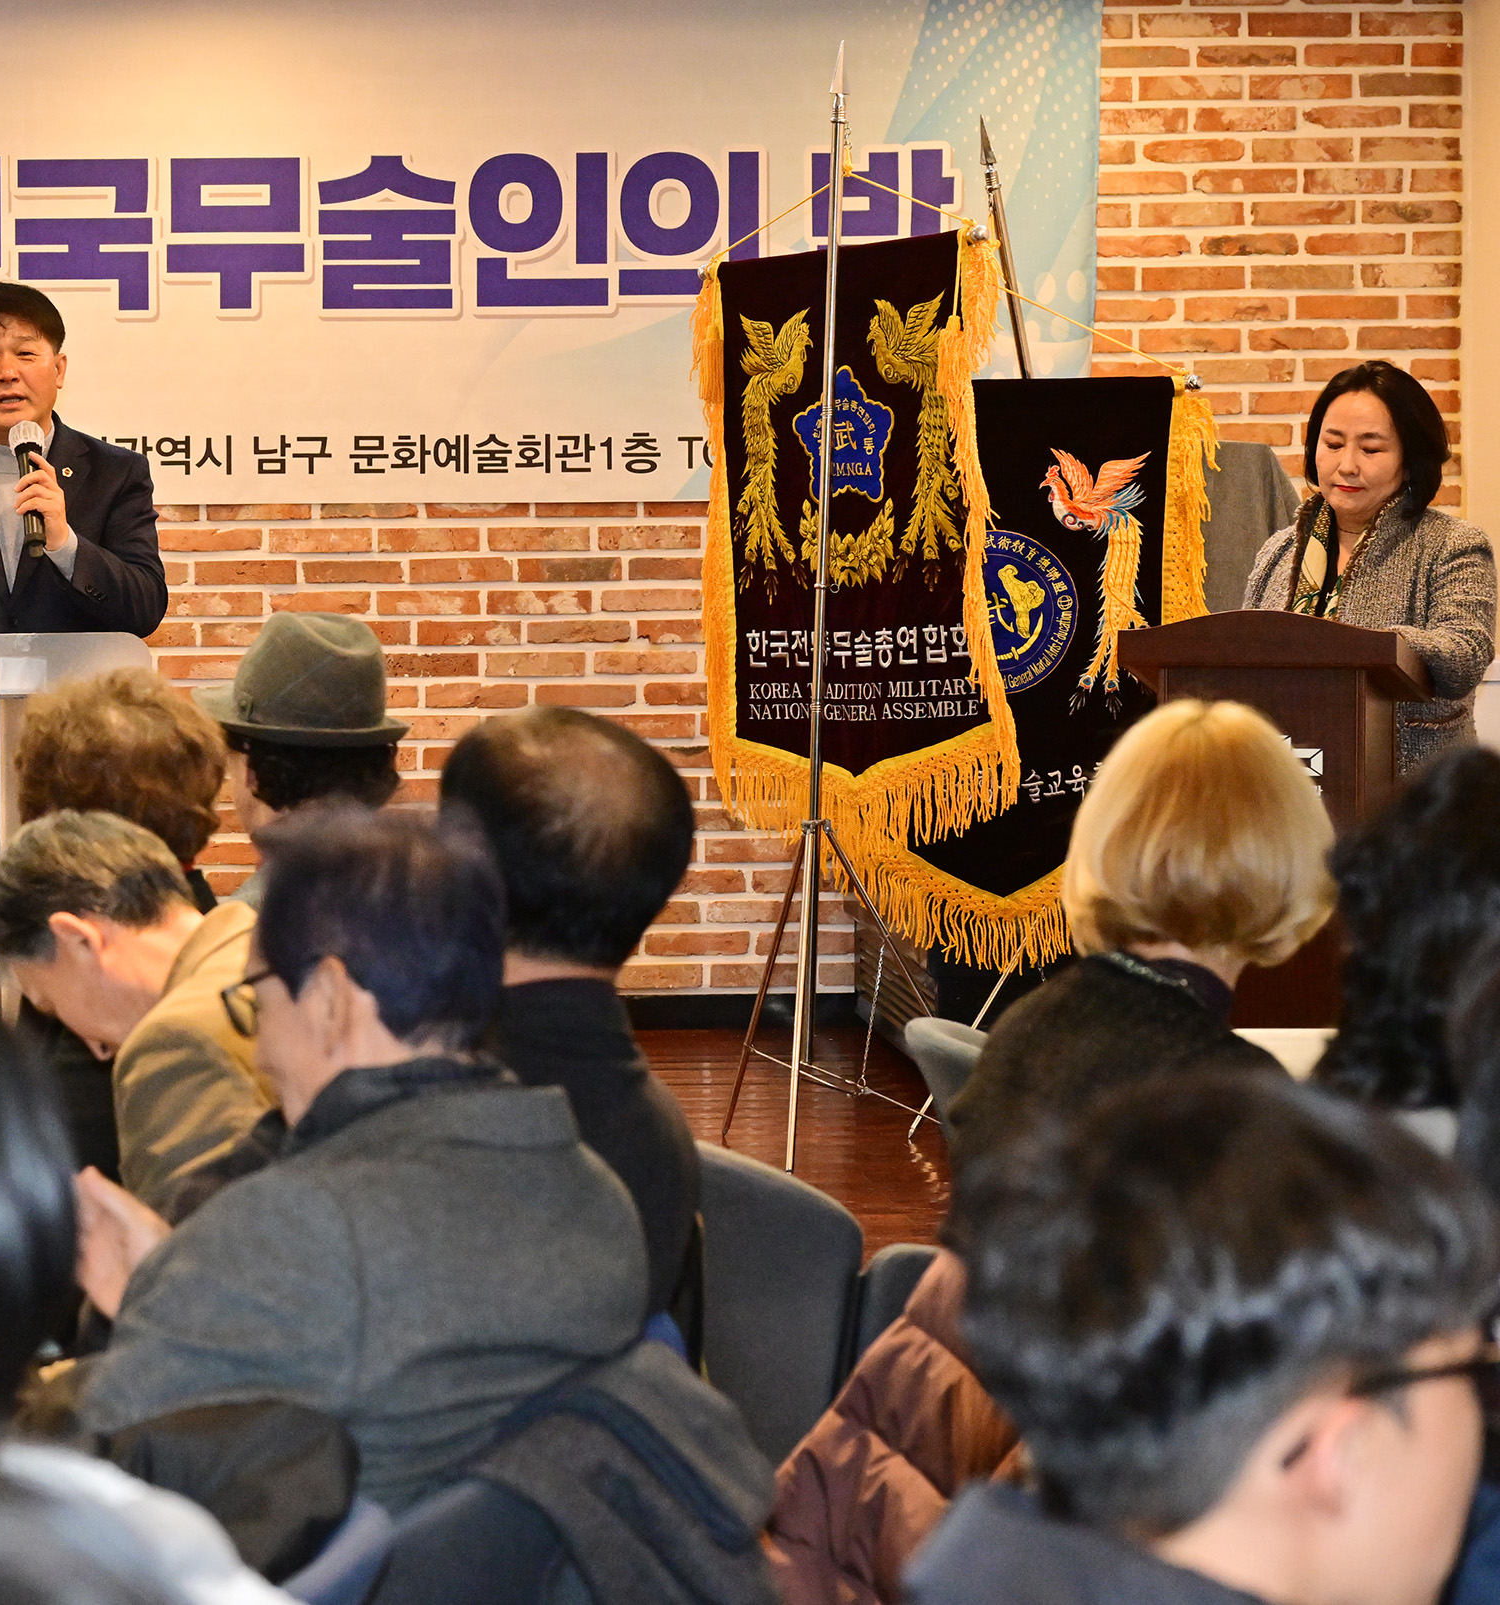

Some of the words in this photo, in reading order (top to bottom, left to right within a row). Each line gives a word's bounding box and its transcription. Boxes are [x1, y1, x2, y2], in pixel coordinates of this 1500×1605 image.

[253, 435, 332, 474] 남구
[348, 434, 662, 474] 문화예술회관1층
[832, 462, 873, 477] MNGA
[749, 682, 802, 699] KOREA
[807, 681, 882, 700] TADITION
[888, 678, 979, 699] MILITARY
[823, 703, 877, 721] GENERA
[882, 699, 979, 719] ASSEMBLE
